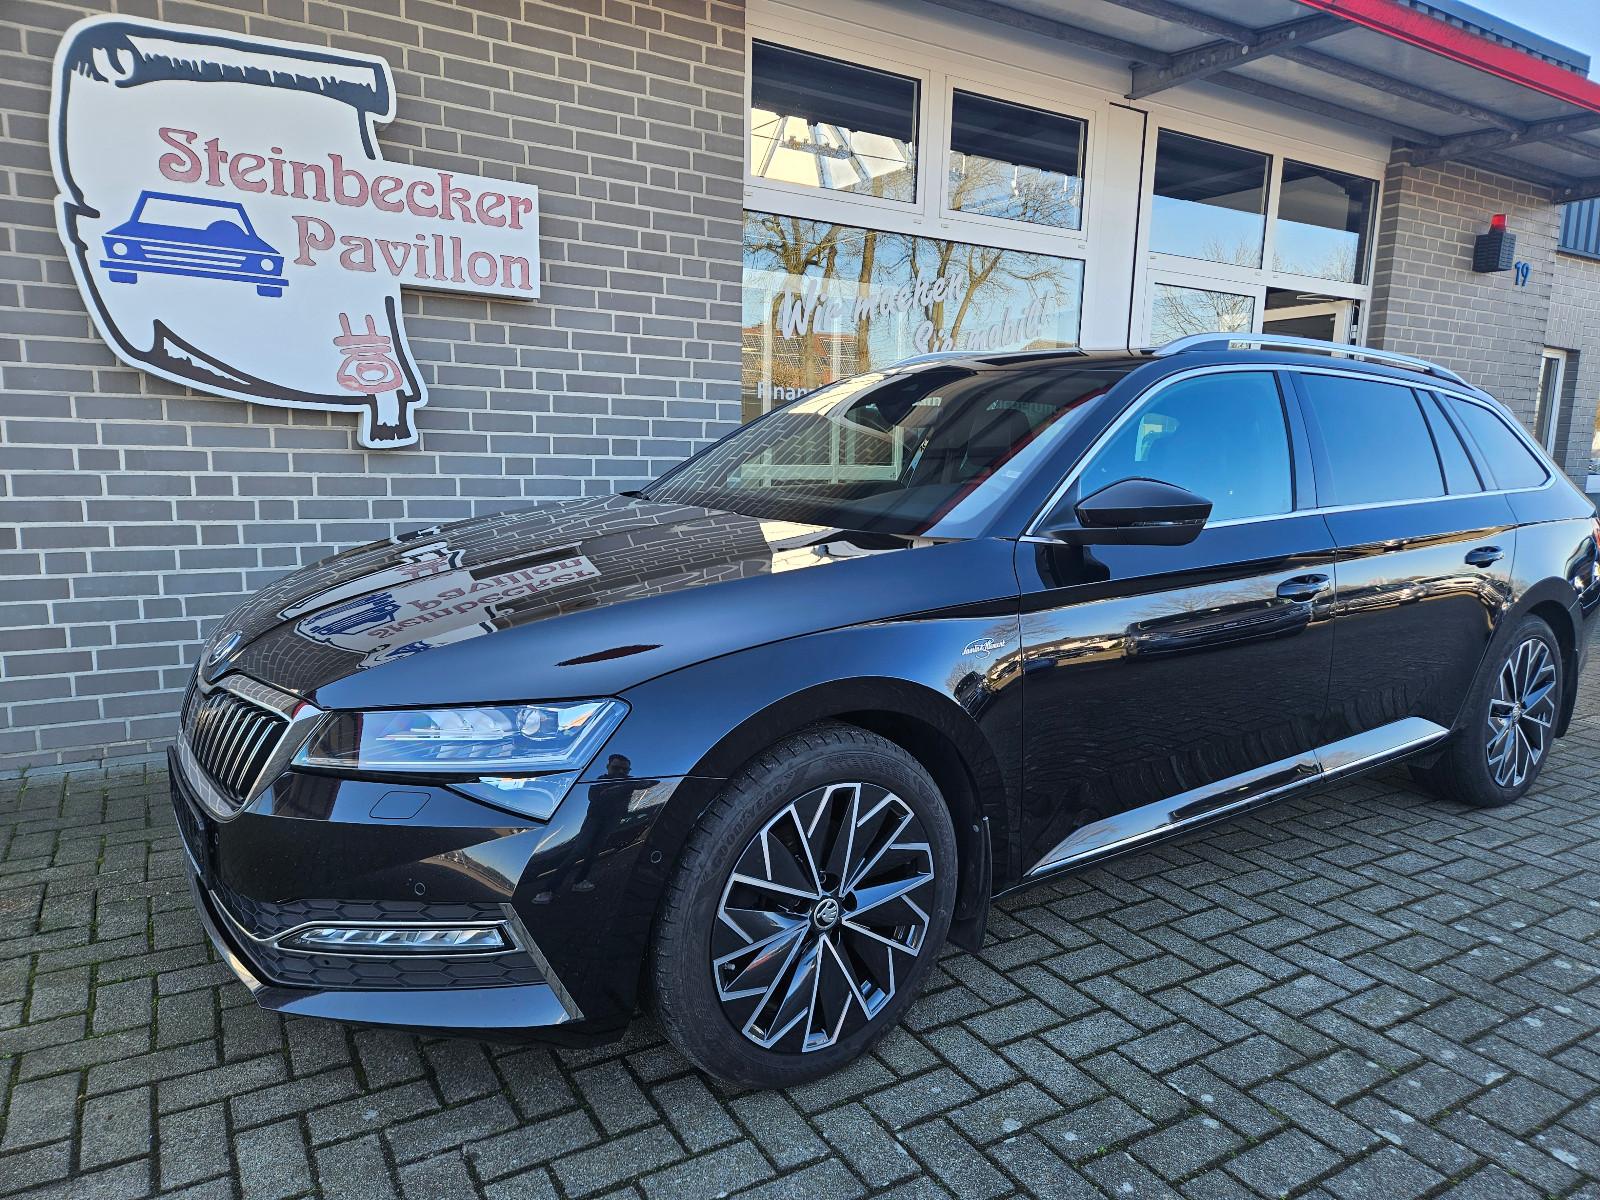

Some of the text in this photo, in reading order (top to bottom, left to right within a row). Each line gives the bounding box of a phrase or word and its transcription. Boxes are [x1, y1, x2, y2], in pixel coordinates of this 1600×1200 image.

[158, 127, 533, 230] Steinbecker
[291, 215, 533, 290] Pavillon
[1514, 260, 1530, 287] 19
[779, 267, 964, 340] Wir machen
